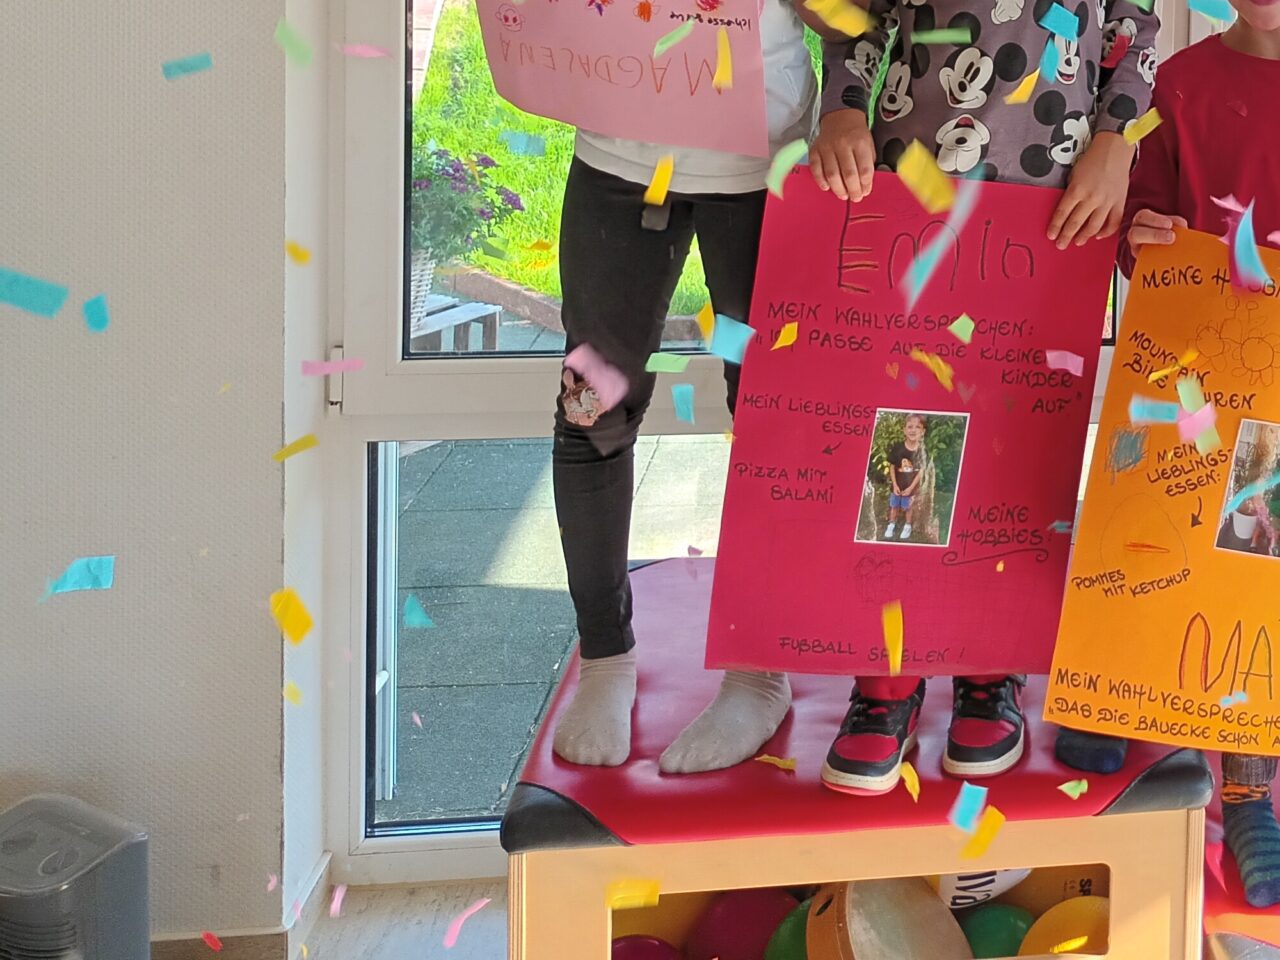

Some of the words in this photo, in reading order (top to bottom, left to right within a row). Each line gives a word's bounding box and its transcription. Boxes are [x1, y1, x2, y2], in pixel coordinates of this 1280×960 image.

[499, 32, 724, 97] MAGDALENA
[1142, 265, 1204, 289] MEINE
[767, 300, 822, 322] MEIN
[834, 306, 1035, 347] WAHLVERSPCHEN:
[808, 328, 873, 352] PASSE
[936, 343, 967, 359] DIE
[980, 346, 1049, 366] KLEINE
[1001, 368, 1074, 389] KINDER
[742, 393, 780, 410] MEIN
[1157, 443, 1200, 464] MEIN
[734, 462, 789, 481] PIZZA
[796, 467, 828, 481] MIT
[770, 485, 834, 504] SALAMI
[967, 505, 1030, 522] MEINE
[1071, 569, 1126, 591] POMMES
[1104, 583, 1126, 598] MIT
[1130, 568, 1192, 598] KETCHUP
[1055, 667, 1101, 693] MEIN
[1096, 707, 1130, 726] DIE
[1133, 715, 1211, 740] BAUECKE
